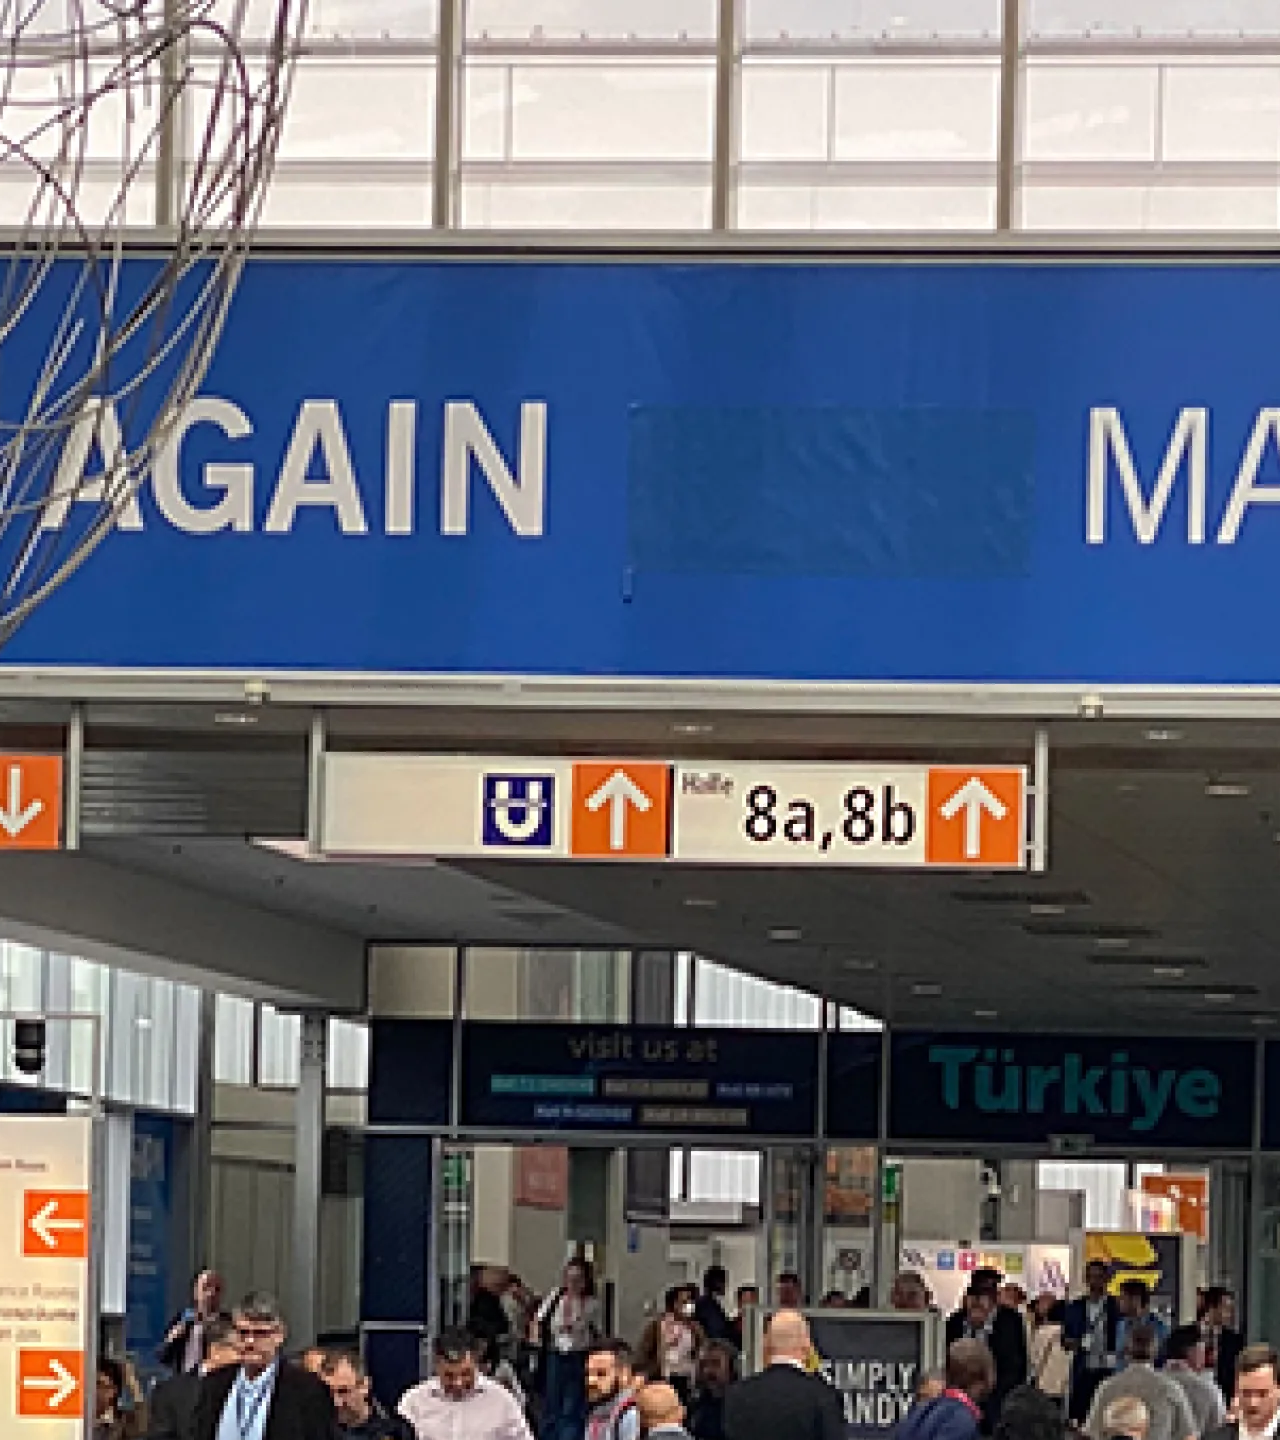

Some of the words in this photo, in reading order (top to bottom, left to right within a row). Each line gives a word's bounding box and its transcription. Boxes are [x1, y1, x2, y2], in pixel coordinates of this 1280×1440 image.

[41, 394, 550, 538] AGAIN
[744, 784, 917, 853] 8a,8b
[567, 1032, 632, 1060] visit
[643, 1039, 678, 1062] us
[686, 1038, 718, 1063] at
[928, 1045, 1221, 1130] Türkiye
[822, 1359, 917, 1391] SIMPLY
